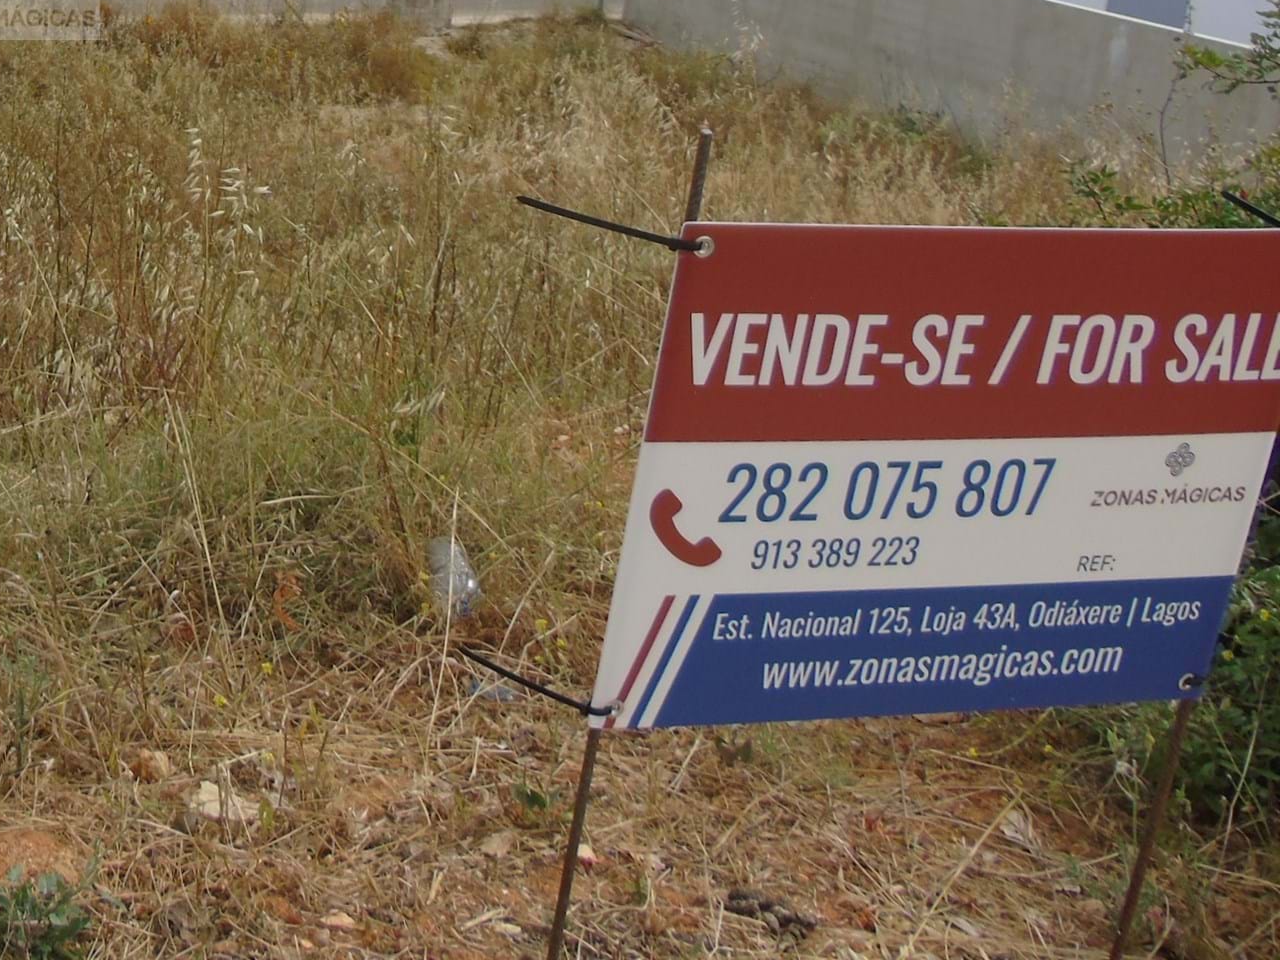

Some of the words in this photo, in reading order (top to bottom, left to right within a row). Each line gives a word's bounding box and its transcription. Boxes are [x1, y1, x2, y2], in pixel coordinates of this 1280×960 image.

[690, 312, 985, 386] VENDE-SE
[1036, 313, 1155, 384] FOR
[718, 462, 829, 523] 282
[843, 460, 943, 521] 075
[955, 457, 1057, 518] 807
[1090, 489, 1158, 507] ZONAS
[1160, 483, 1246, 505] MÁGICAS
[750, 539, 801, 570] 913
[807, 538, 861, 569] 389
[867, 536, 920, 566] 223
[1076, 554, 1116, 572] REF:
[712, 612, 753, 640] Est.
[761, 608, 862, 639] Nacional
[869, 606, 913, 637] 125,
[920, 605, 966, 636] Loja
[972, 602, 1020, 632] 43A,
[1028, 599, 1123, 628] Odiáxere
[1140, 596, 1201, 627] Lagos
[762, 644, 1124, 690] www.zonasmagicas.com
